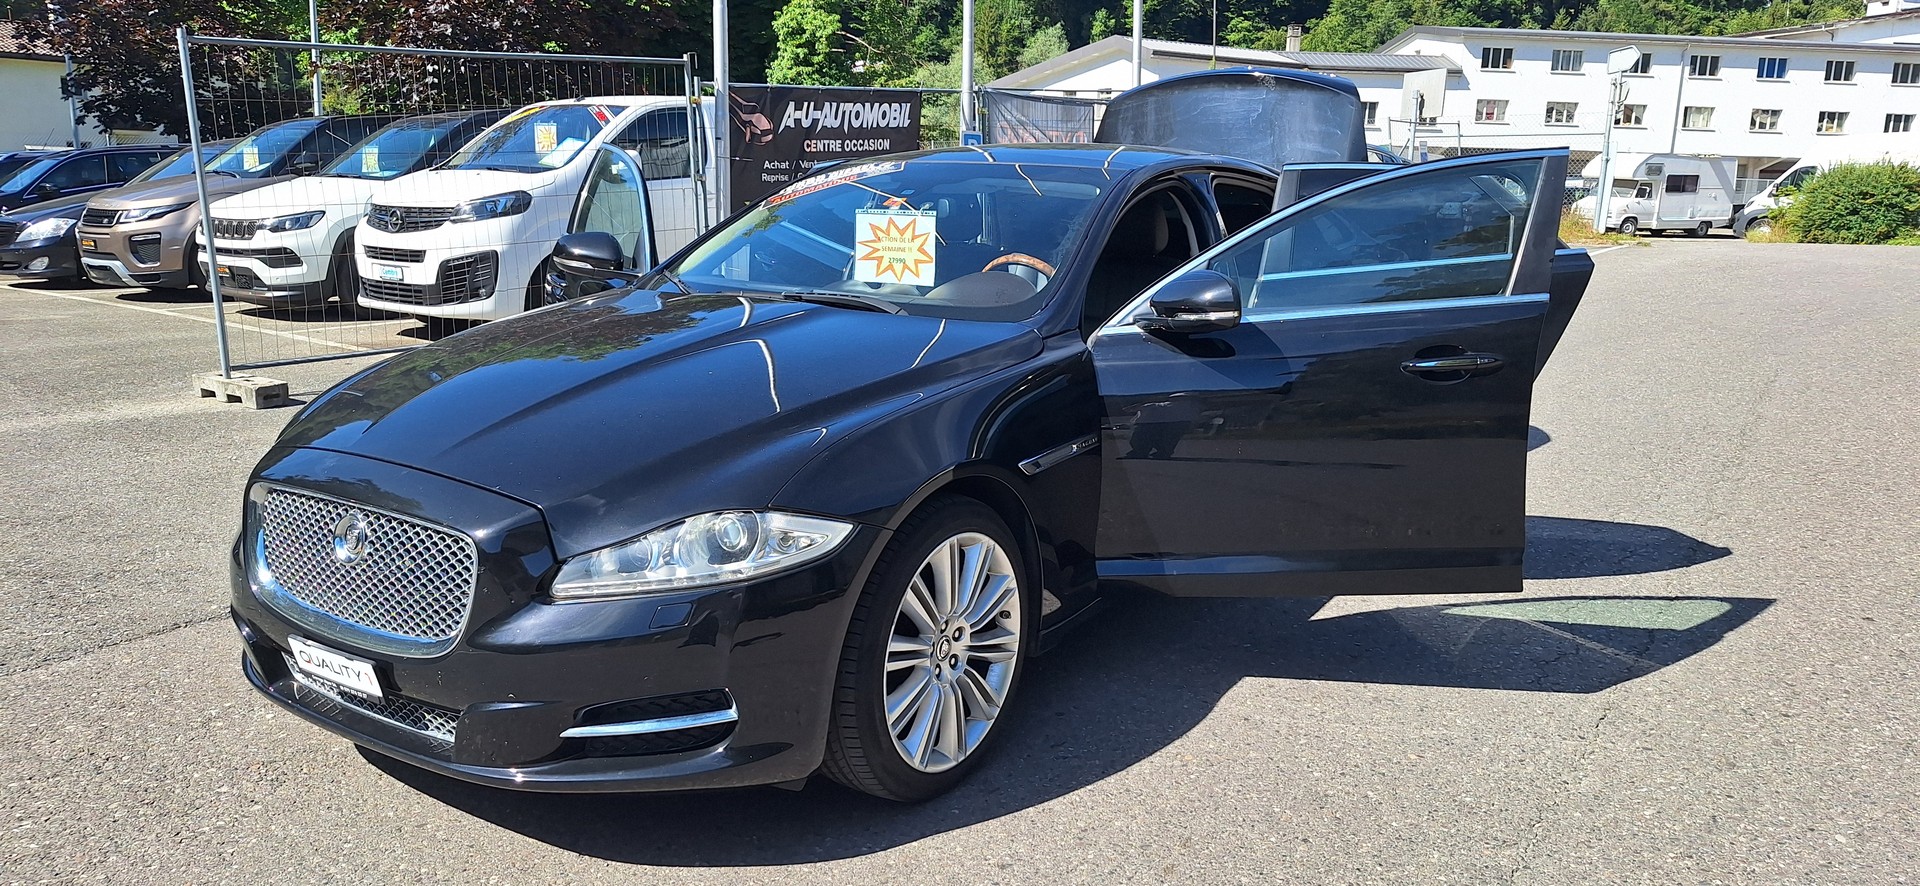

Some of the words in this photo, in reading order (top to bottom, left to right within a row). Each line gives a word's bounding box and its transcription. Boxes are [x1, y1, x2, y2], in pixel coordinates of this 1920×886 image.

[777, 101, 912, 134] A-U-AUTOMOBIL
[803, 139, 842, 152] CENTRE
[844, 139, 890, 151] OCCASION
[763, 160, 790, 169] Achat
[799, 160, 817, 168] Vent
[761, 173, 789, 183] Reprise
[299, 650, 361, 682] QUALITY
